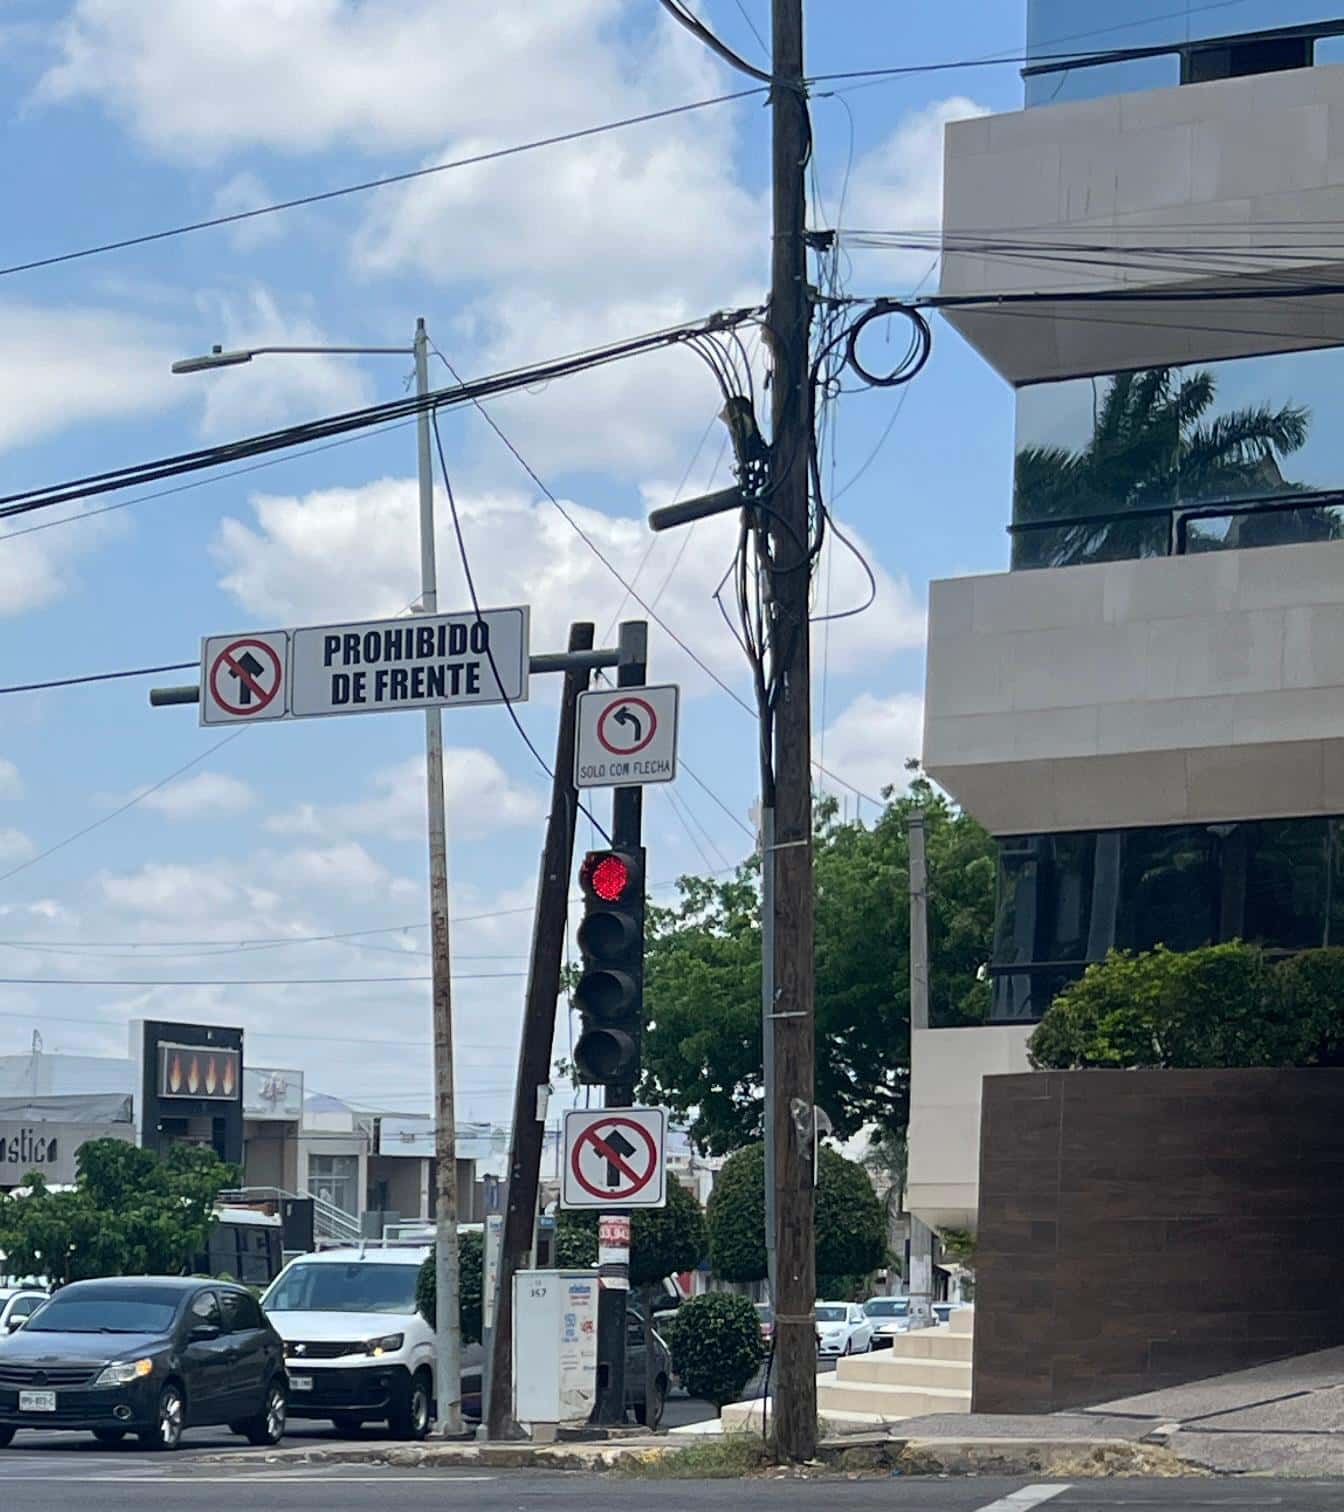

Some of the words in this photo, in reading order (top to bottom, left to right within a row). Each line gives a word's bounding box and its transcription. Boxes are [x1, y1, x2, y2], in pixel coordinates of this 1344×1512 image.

[323, 620, 490, 668] PROHIBIDO
[331, 671, 367, 705] DE
[374, 661, 481, 702] FRENTE
[580, 764, 606, 779] SOLO
[609, 762, 630, 777] CON
[632, 759, 671, 775] FLECHA
